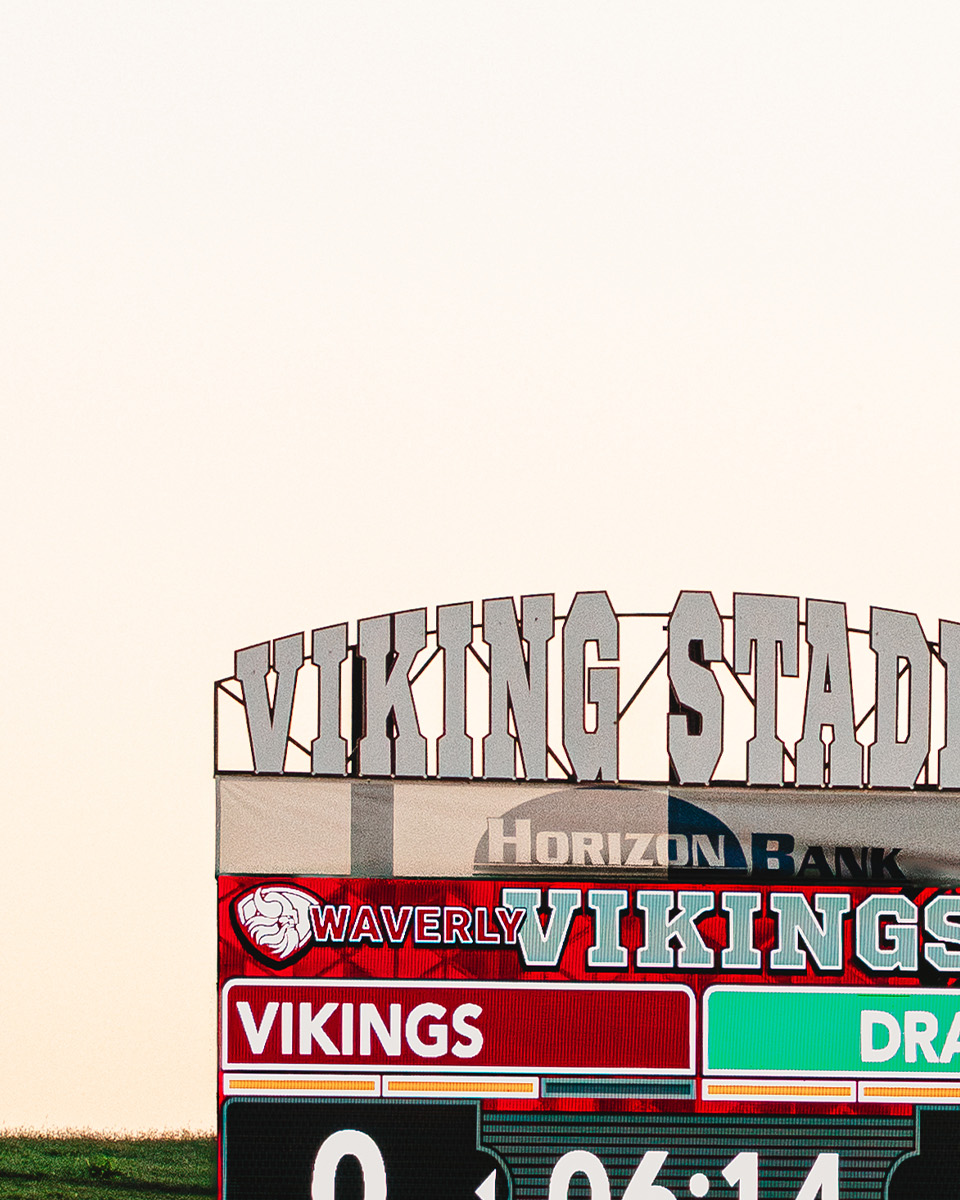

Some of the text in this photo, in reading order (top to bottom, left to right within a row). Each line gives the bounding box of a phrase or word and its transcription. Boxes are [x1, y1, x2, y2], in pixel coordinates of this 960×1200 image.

[234, 590, 620, 783] VIKING
[486, 816, 906, 880] HORIZON BANK
[309, 905, 526, 945] WAVERLY
[235, 1001, 484, 1059] VIKINGS
